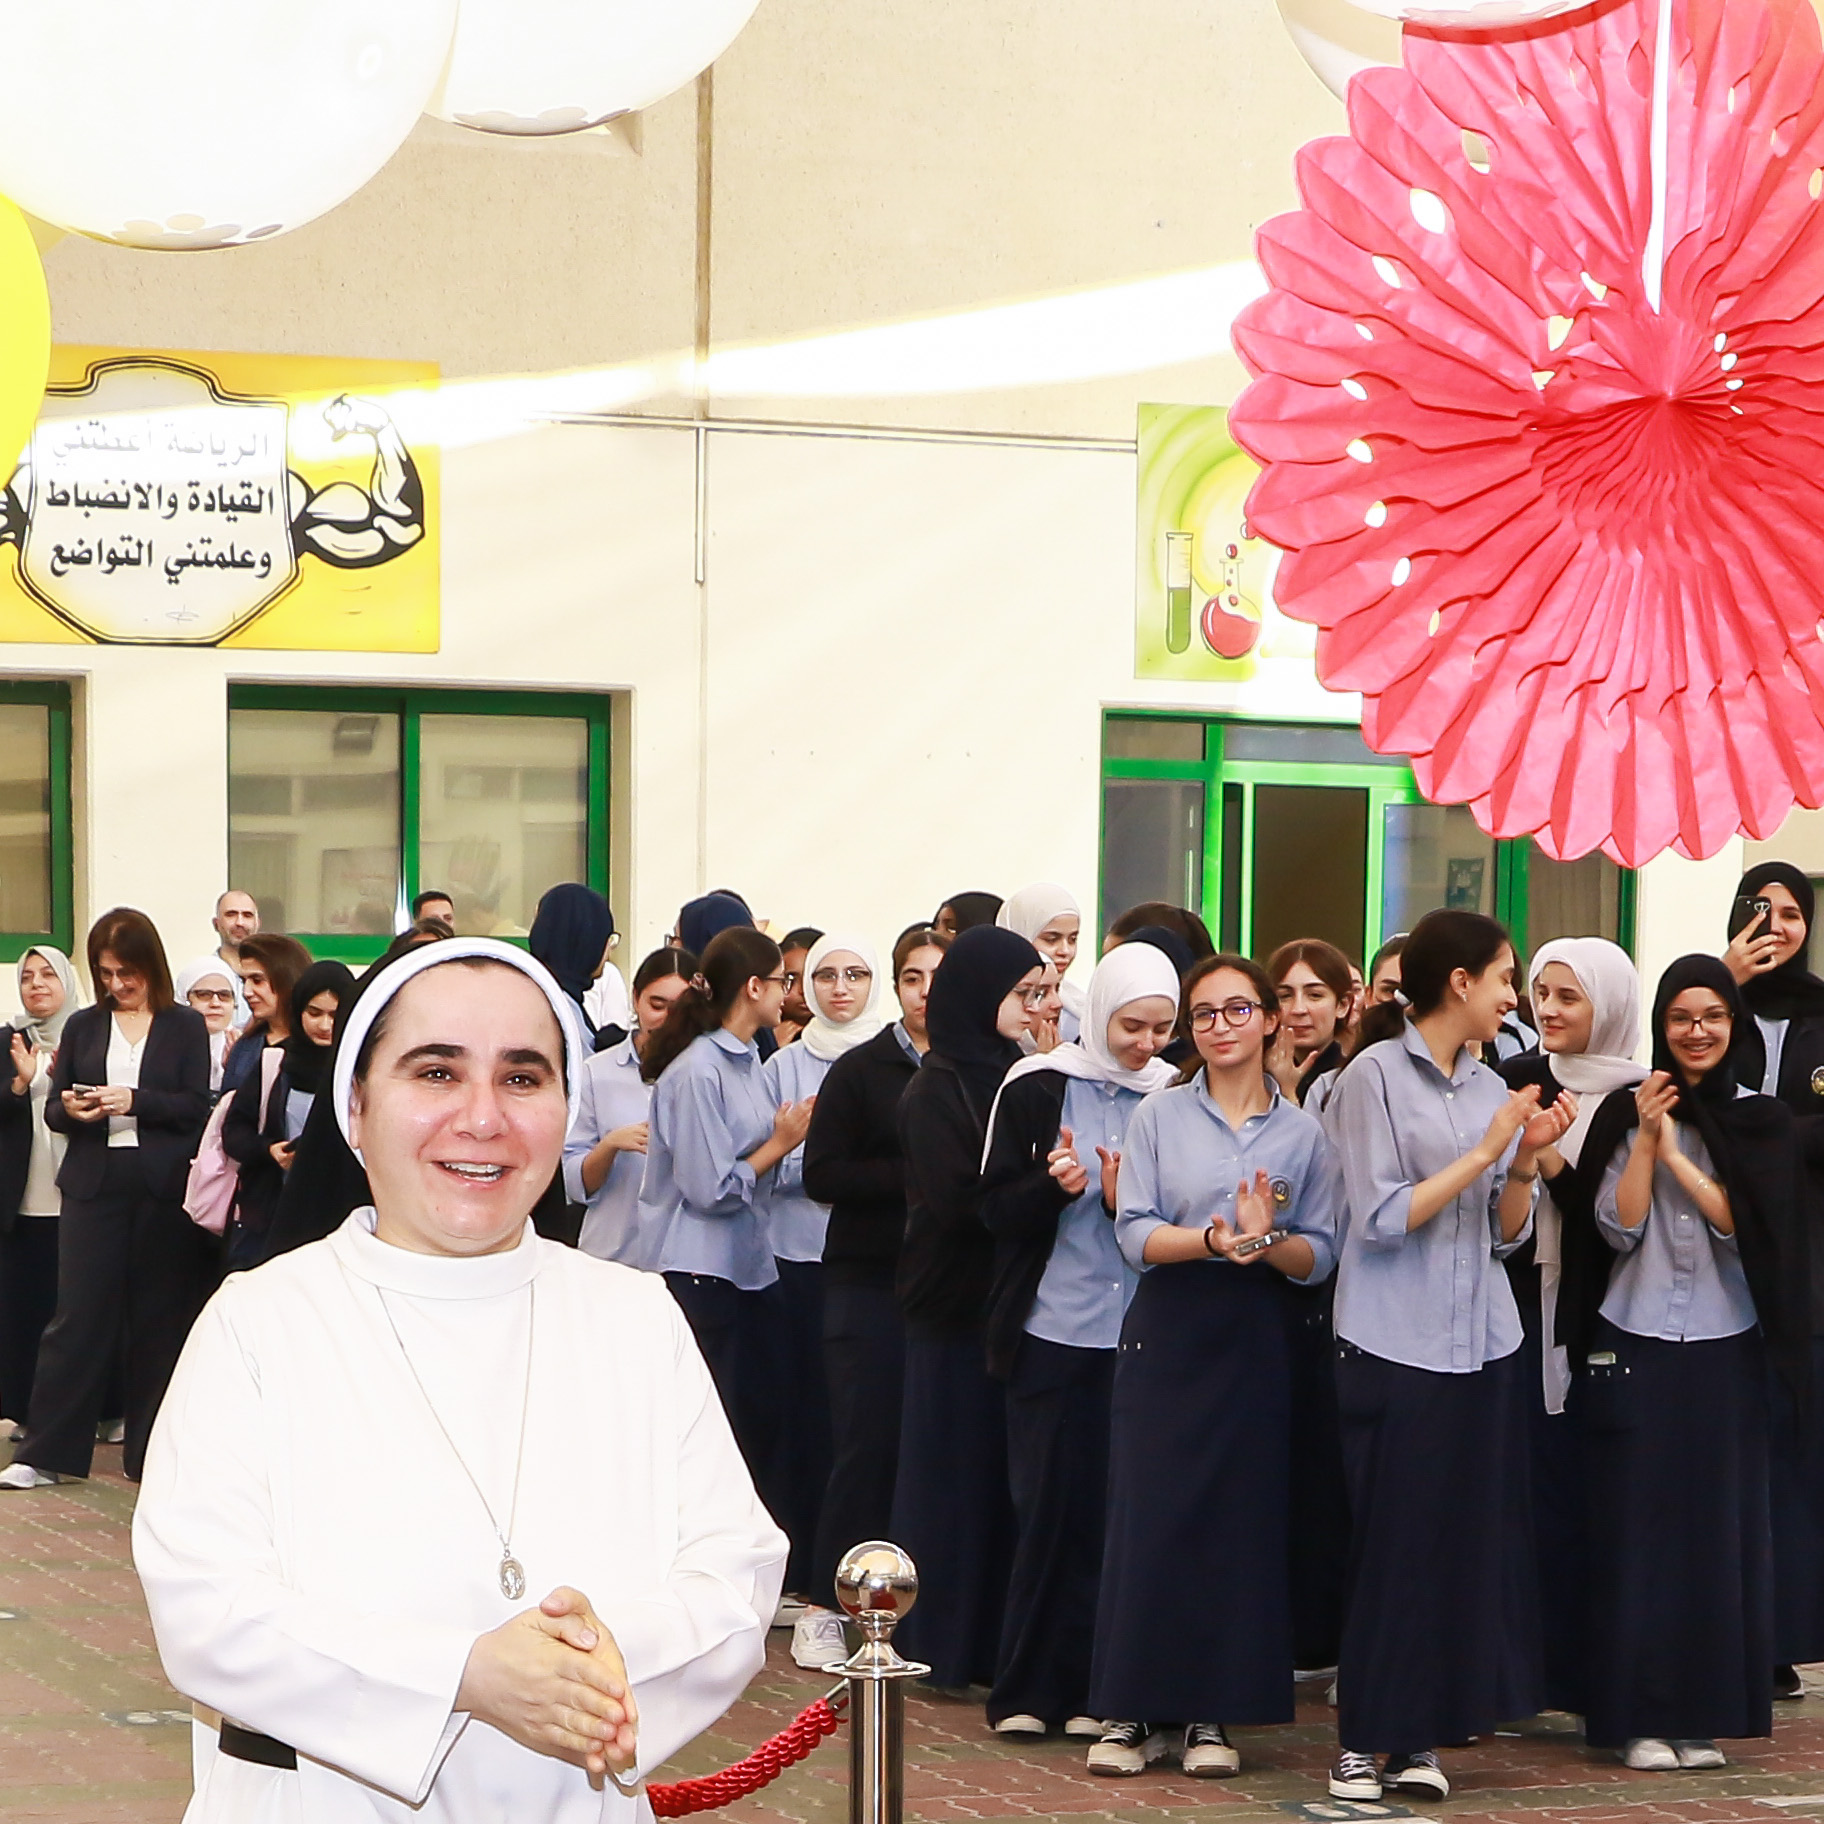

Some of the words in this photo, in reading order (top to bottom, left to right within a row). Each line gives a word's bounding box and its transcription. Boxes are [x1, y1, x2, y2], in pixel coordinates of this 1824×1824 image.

[45, 478, 179, 519] والانضباط
[187, 480, 274, 523] القيادة
[50, 534, 154, 578] التواضع
[163, 537, 272, 586] وعلمتني
